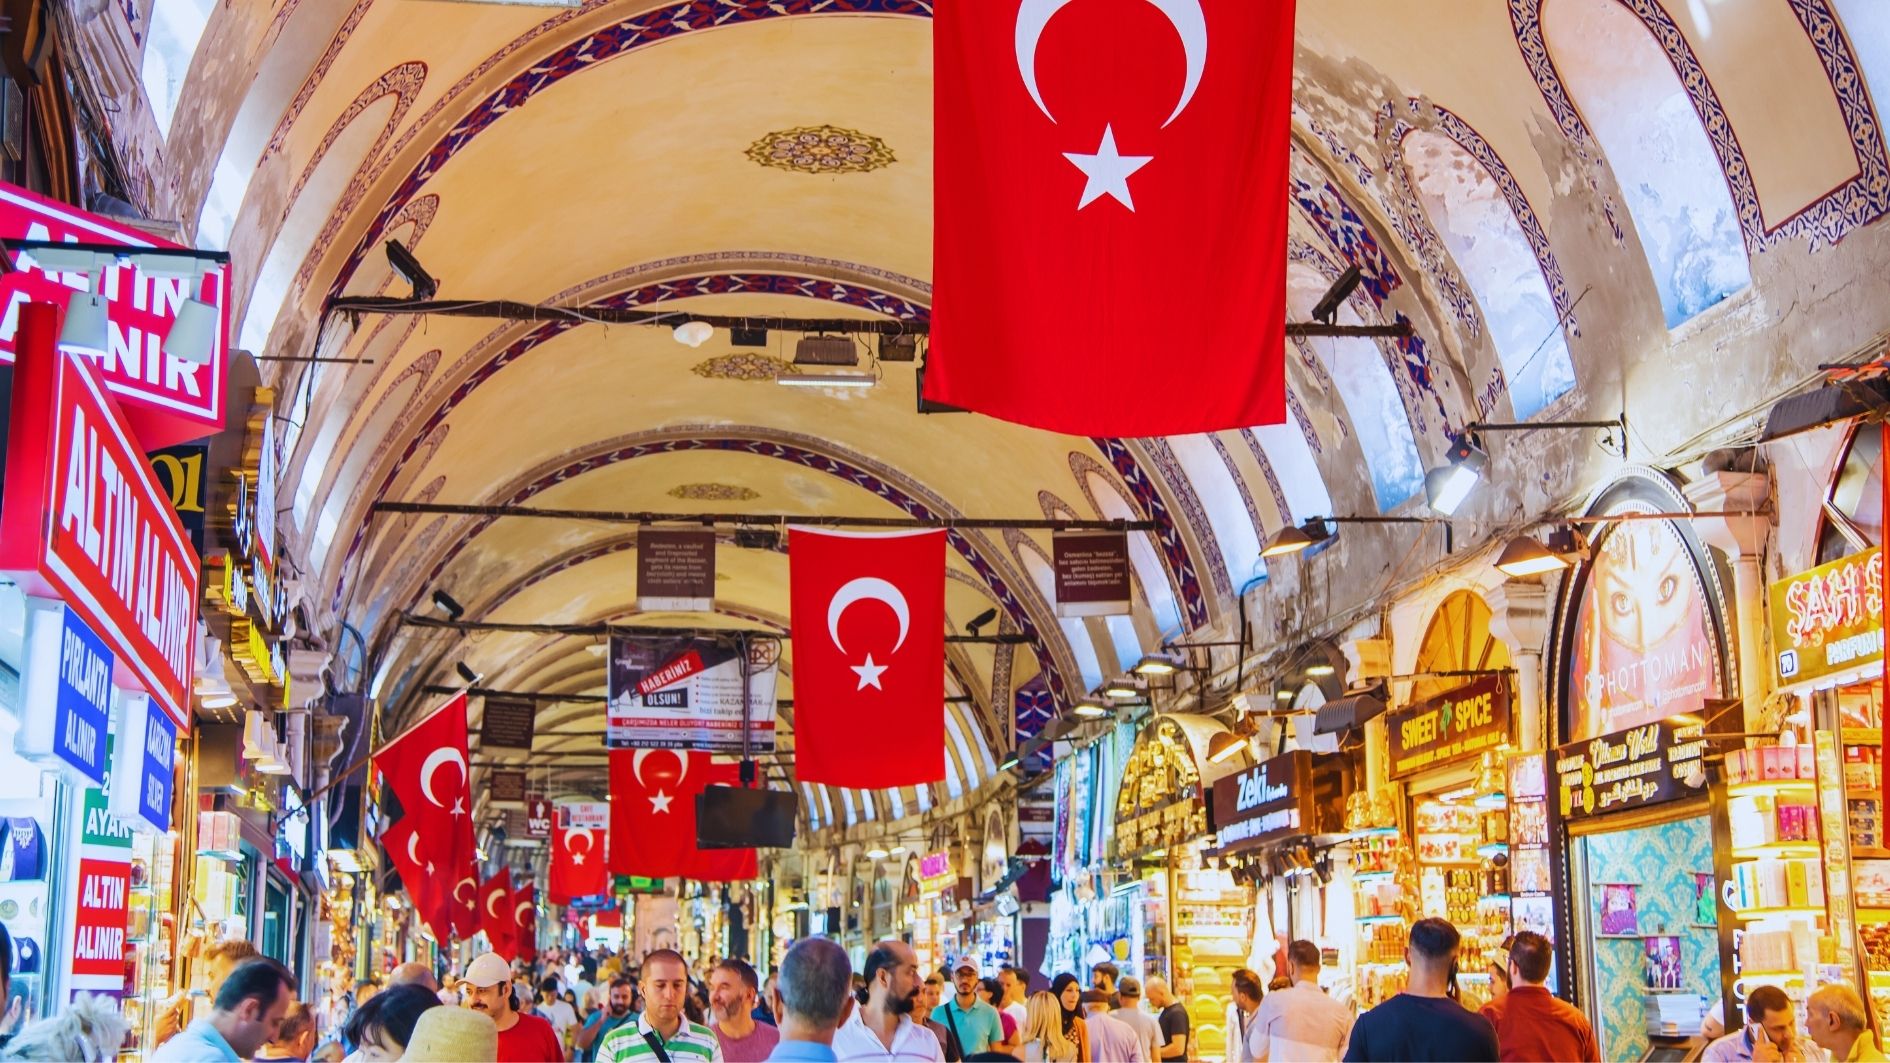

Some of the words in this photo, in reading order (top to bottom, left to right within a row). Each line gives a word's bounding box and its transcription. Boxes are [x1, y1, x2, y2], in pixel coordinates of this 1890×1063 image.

[62, 404, 138, 613] ALTIN
[136, 519, 190, 690] ALINIR
[62, 626, 109, 715] PIRLANTA
[640, 659, 692, 693] HABERİNİZ
[647, 692, 682, 706] OLSUN!
[64, 709, 97, 768] ALINIR
[1401, 710, 1439, 751] SWEET
[1455, 692, 1493, 733] SPICE
[1236, 763, 1268, 812] Zeki
[528, 817, 551, 830] WC
[82, 874, 125, 910] ALTIN
[75, 925, 123, 961] ALINIR
